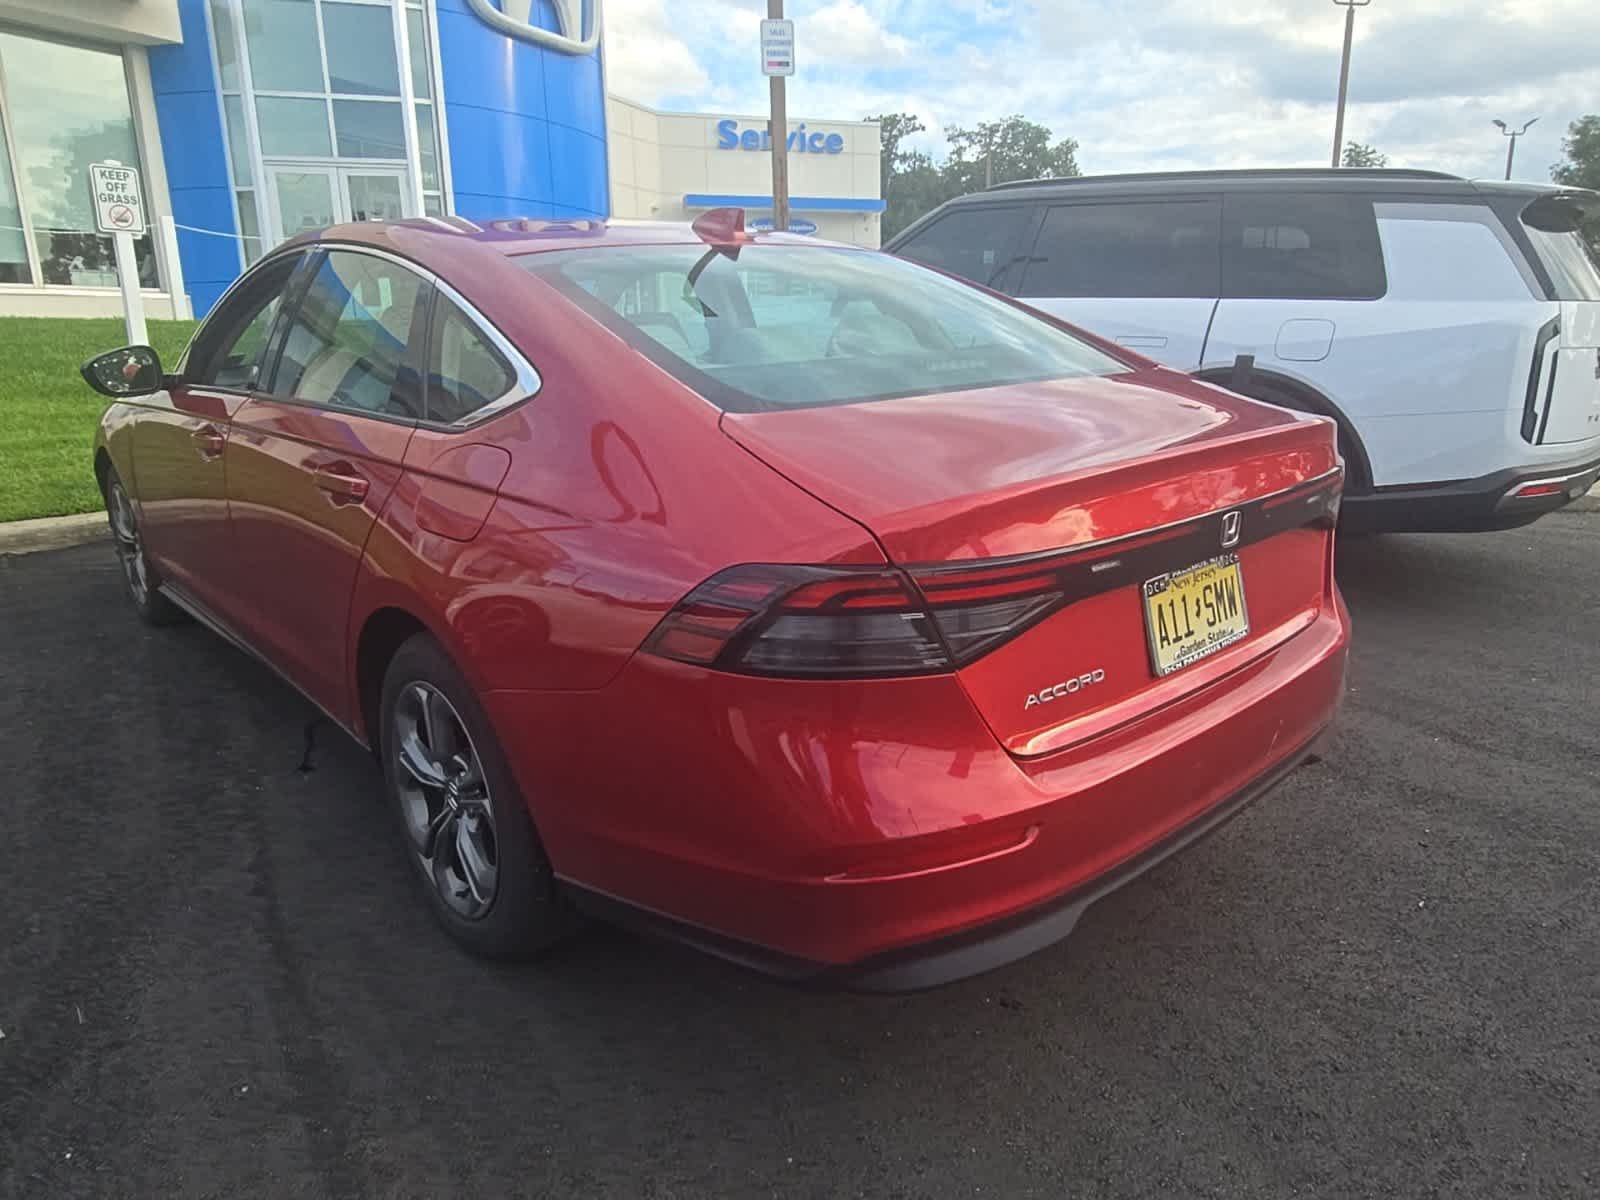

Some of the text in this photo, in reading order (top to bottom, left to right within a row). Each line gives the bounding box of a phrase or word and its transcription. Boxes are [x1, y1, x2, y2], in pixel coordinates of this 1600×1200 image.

[100, 170, 129, 181] KEEP
[106, 182, 128, 192] OFF
[99, 193, 137, 205] GRASS
[1171, 567, 1217, 593] New Jersey
[1180, 629, 1228, 656] Garden State
[1024, 668, 1105, 710] ACCORD
